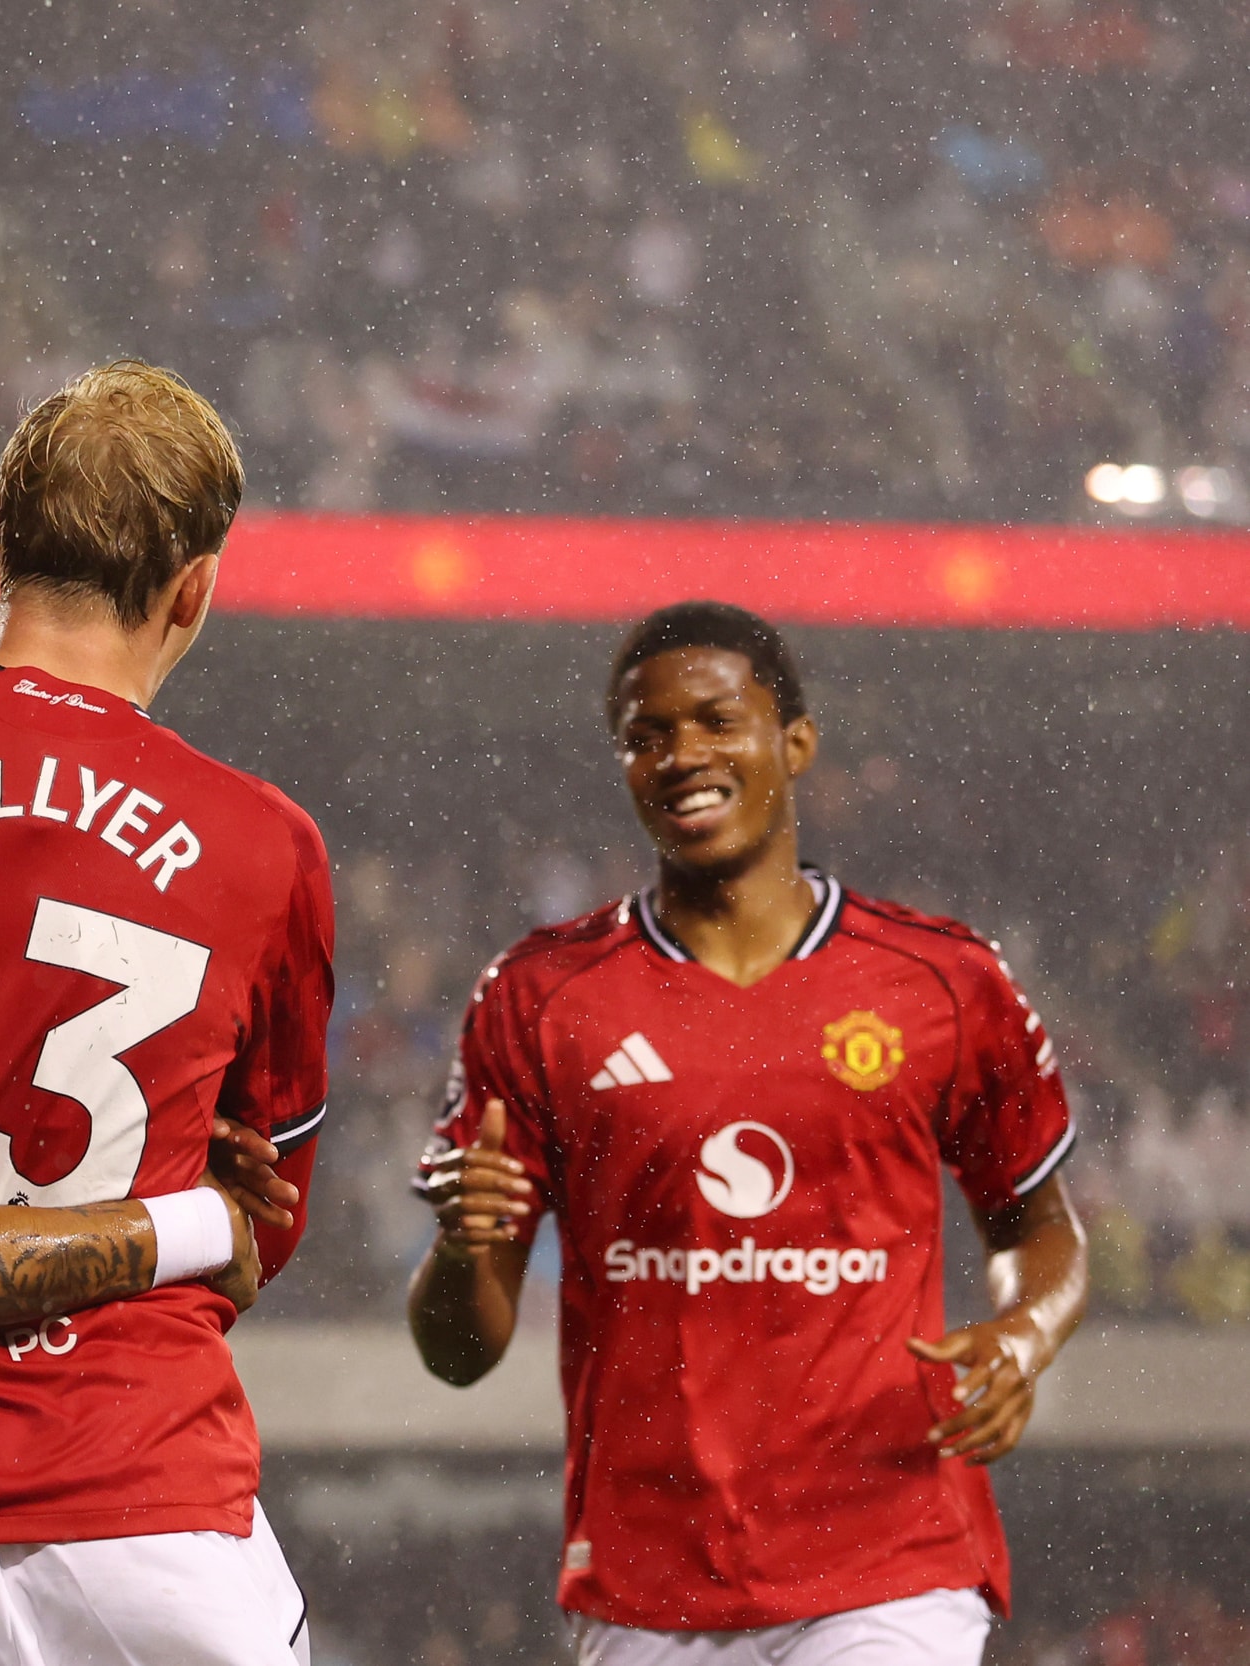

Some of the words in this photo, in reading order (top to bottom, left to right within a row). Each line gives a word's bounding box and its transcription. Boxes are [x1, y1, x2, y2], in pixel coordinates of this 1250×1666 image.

[12, 679, 52, 700] Theatre
[48, 693, 70, 705] of
[64, 693, 108, 714] Dreams
[604, 1236, 888, 1296] Snapdragon
[6, 1315, 78, 1362] PC
